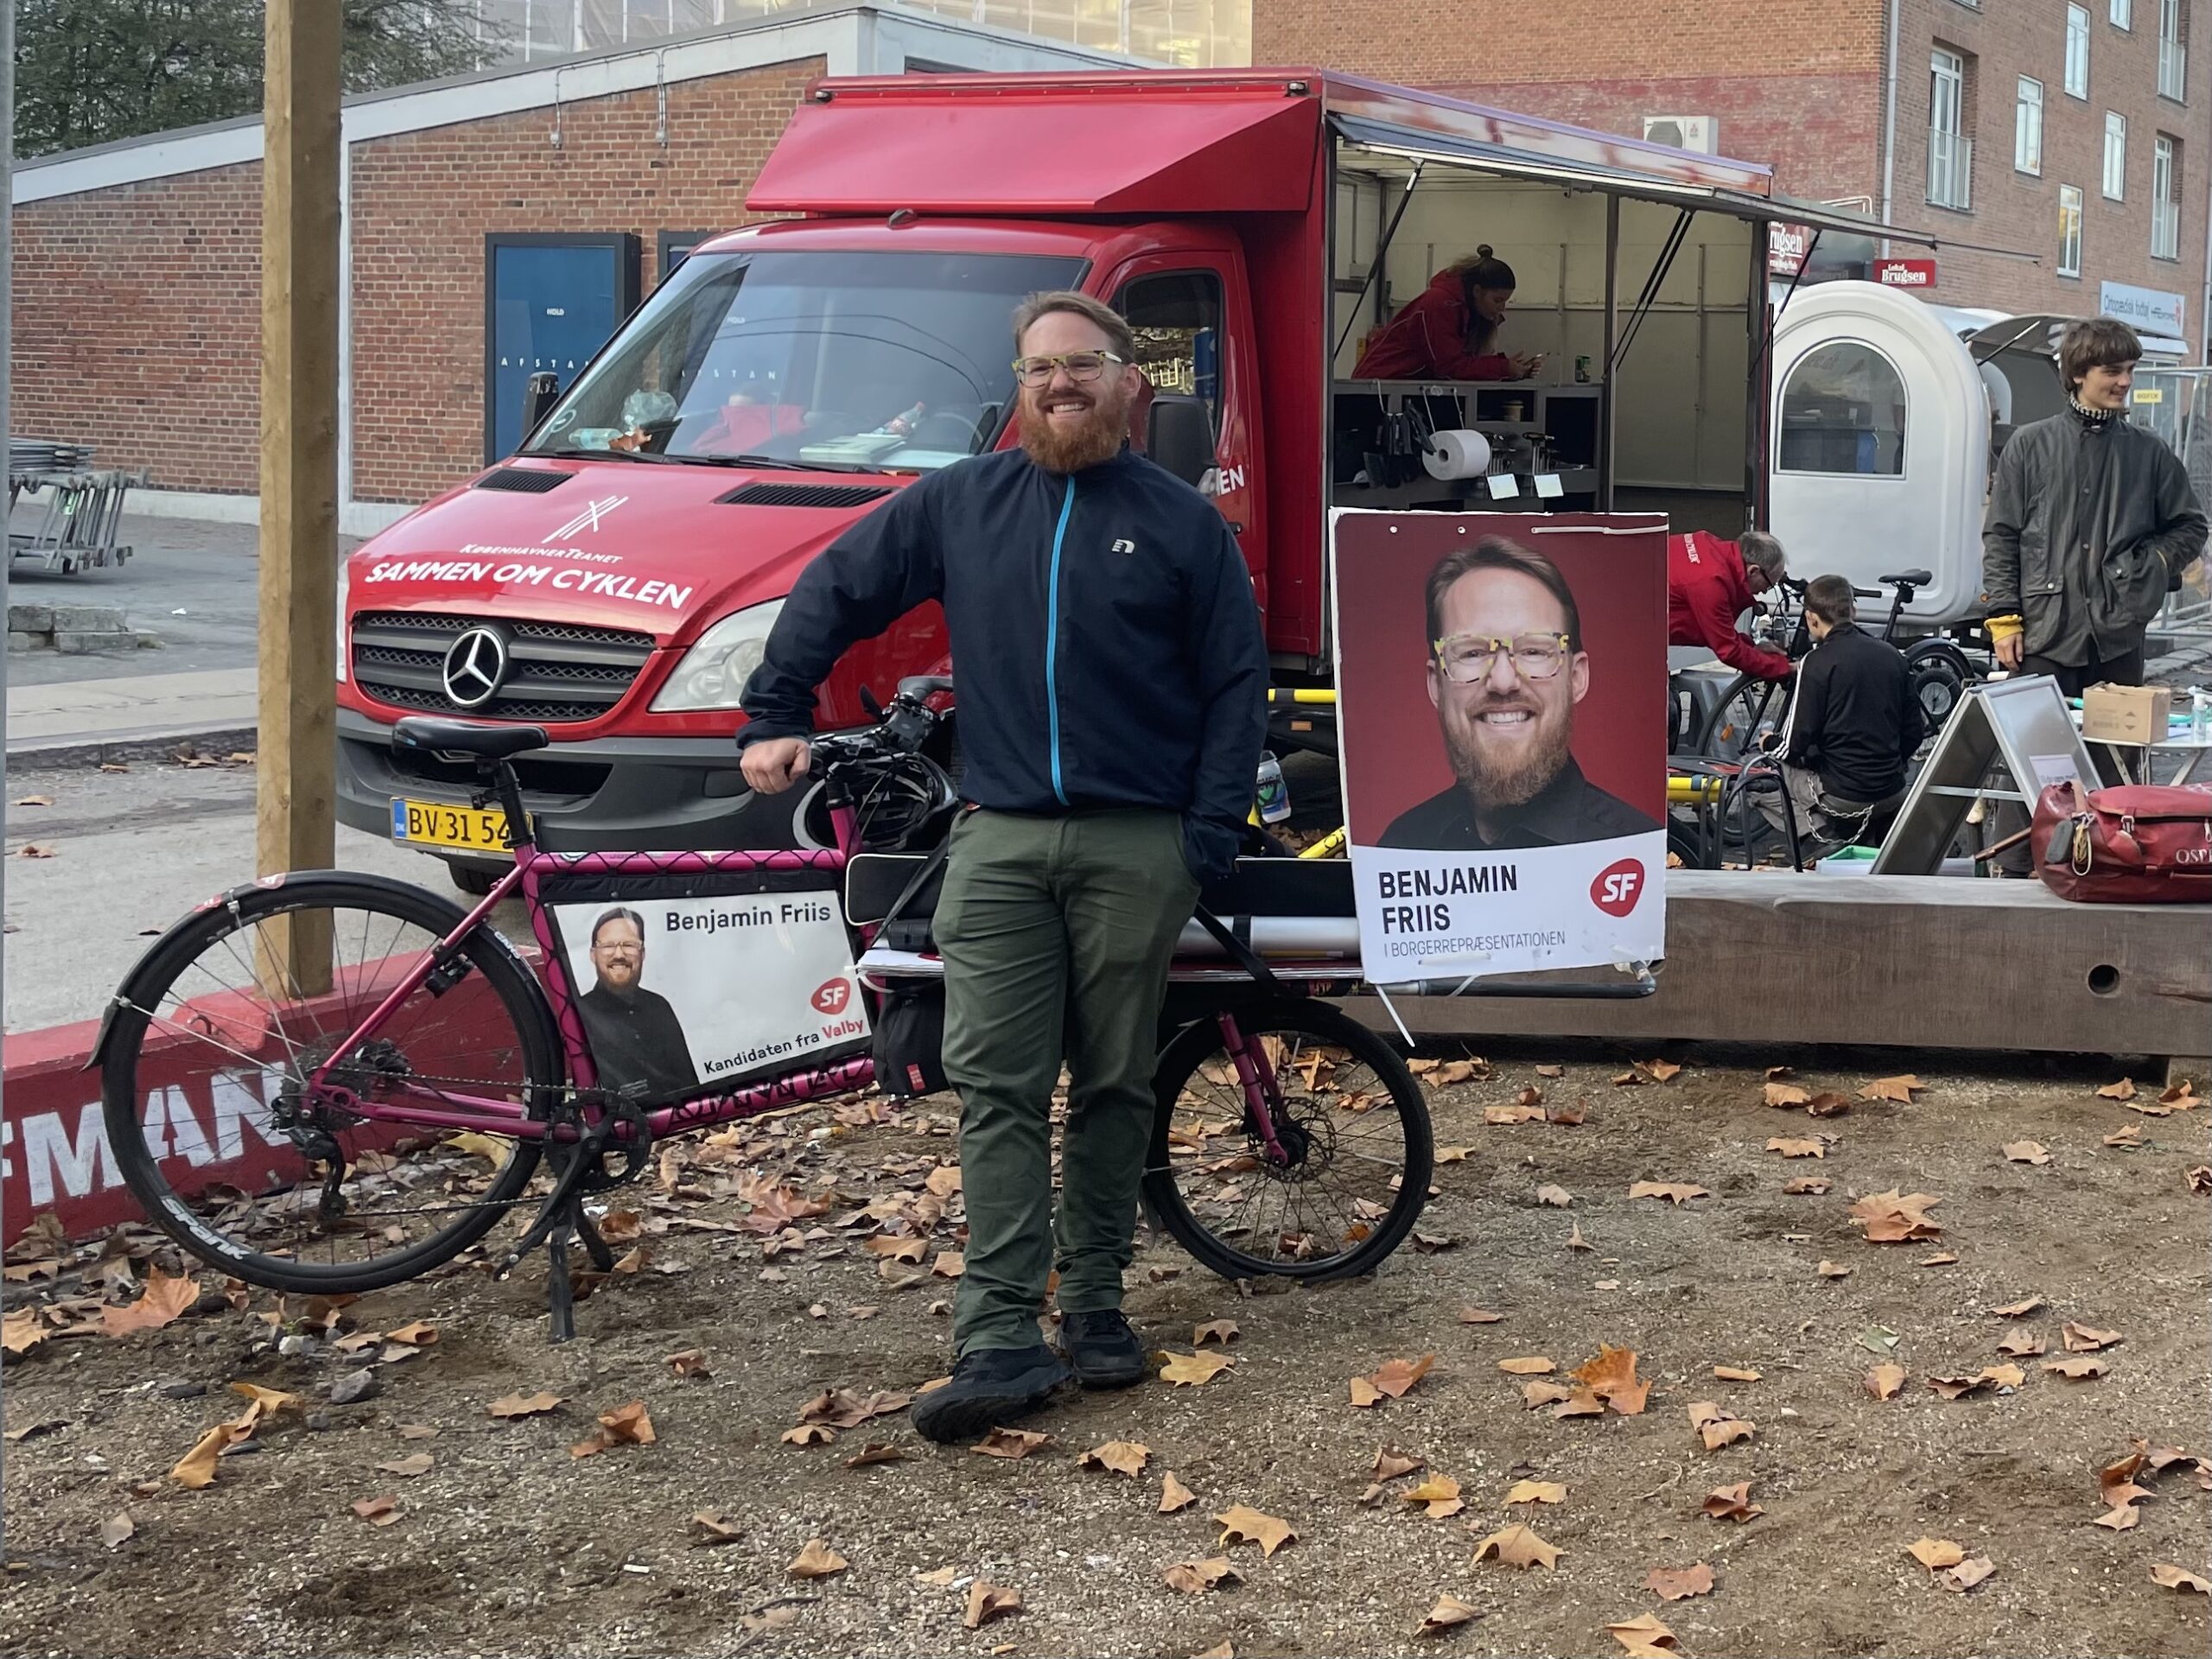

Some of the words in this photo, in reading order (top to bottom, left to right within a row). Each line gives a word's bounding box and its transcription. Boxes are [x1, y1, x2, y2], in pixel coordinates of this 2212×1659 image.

[1769, 226, 1803, 257] rugsen
[1881, 269, 1927, 285] Brugsen
[546, 308, 565, 316] HOLD
[1220, 464, 1245, 495] EN
[365, 562, 494, 582] SAMMEN
[493, 563, 554, 586] OM
[552, 569, 693, 609] CYKLEN
[409, 807, 438, 837] BV
[445, 812, 472, 842] 31
[1378, 864, 1517, 899] BENJAMIN
[1601, 872, 1638, 903] SF
[665, 906, 773, 934] Benjamin
[781, 902, 831, 924] Friis
[1382, 903, 1451, 934] FRIIS
[1390, 931, 1566, 957] BORGERREPRÆSENTATIONEN
[819, 986, 845, 1007] SF
[703, 1040, 793, 1075] Kandidaten
[794, 1033, 821, 1048] fra
[822, 1019, 865, 1039] Valby
[2, 1061, 295, 1207] MAN
